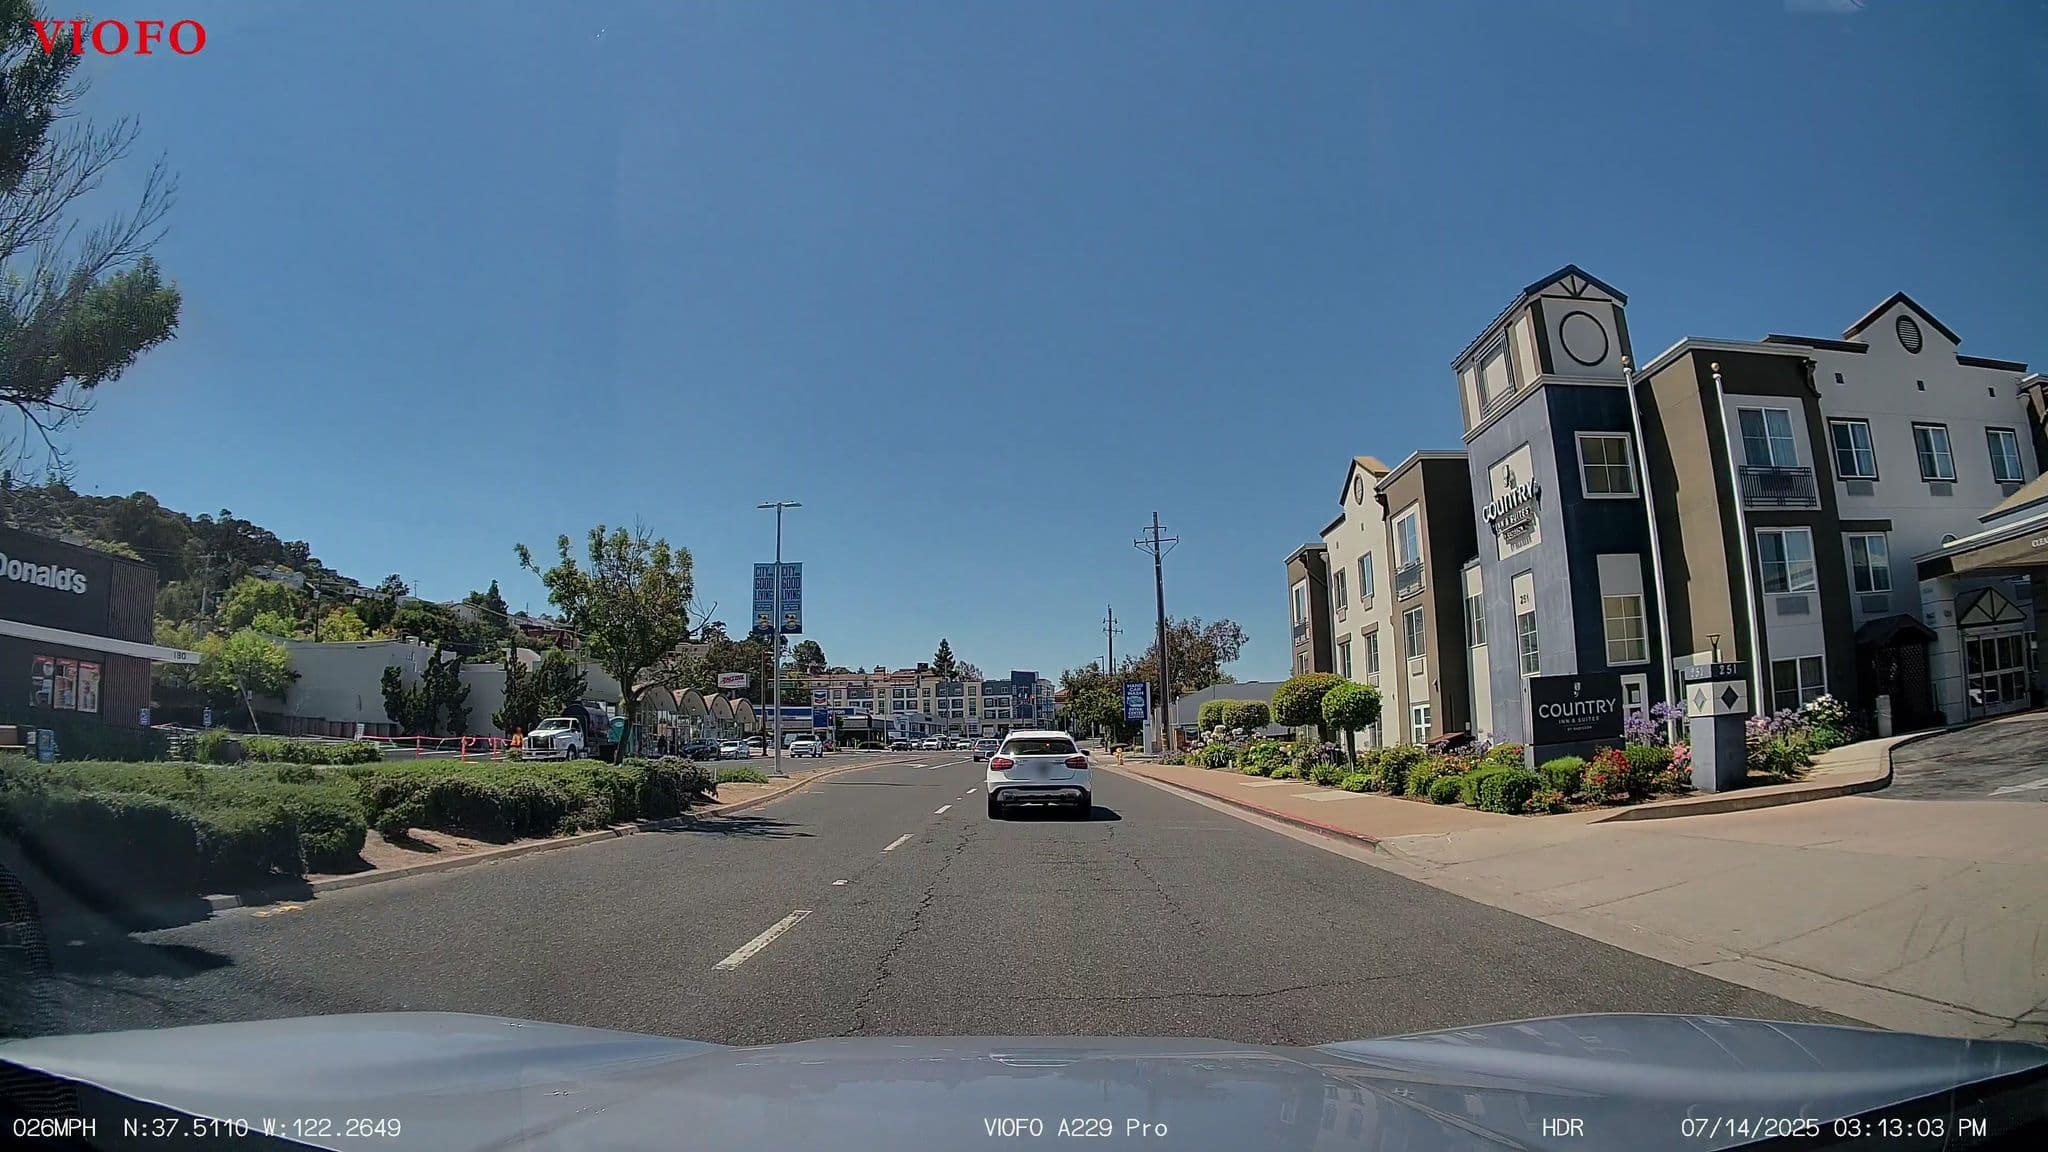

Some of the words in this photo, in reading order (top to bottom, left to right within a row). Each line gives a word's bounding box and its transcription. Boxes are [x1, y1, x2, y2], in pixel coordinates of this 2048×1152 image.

[755, 566, 769, 577] CITY
[781, 565, 795, 577] CITY
[755, 577, 773, 590] GOOD
[782, 576, 800, 589] GOOD
[755, 590, 773, 601] LIVING
[782, 589, 800, 600] LIVING
[1520, 593, 1529, 604] 251
[1720, 664, 1737, 675] 251
